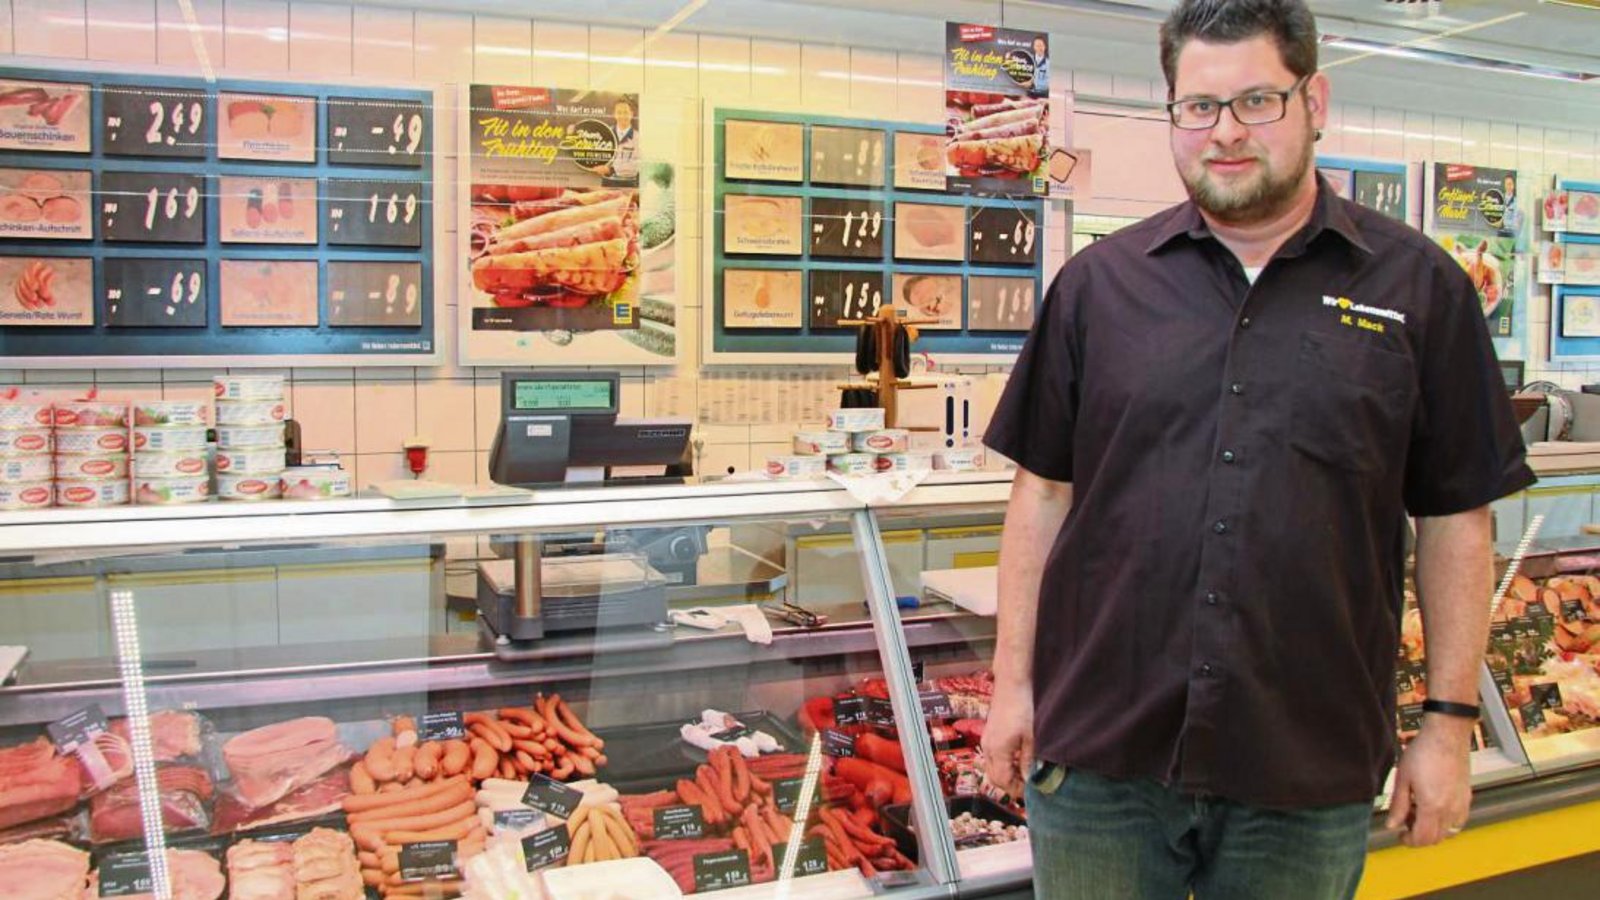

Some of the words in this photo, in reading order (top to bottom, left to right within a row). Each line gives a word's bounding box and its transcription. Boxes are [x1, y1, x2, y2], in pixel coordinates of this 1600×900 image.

[478, 117, 509, 138] Fit
[511, 118, 531, 138] in
[532, 118, 565, 139] den
[480, 137, 558, 165] Frühling
[1357, 317, 1385, 333] Mack
